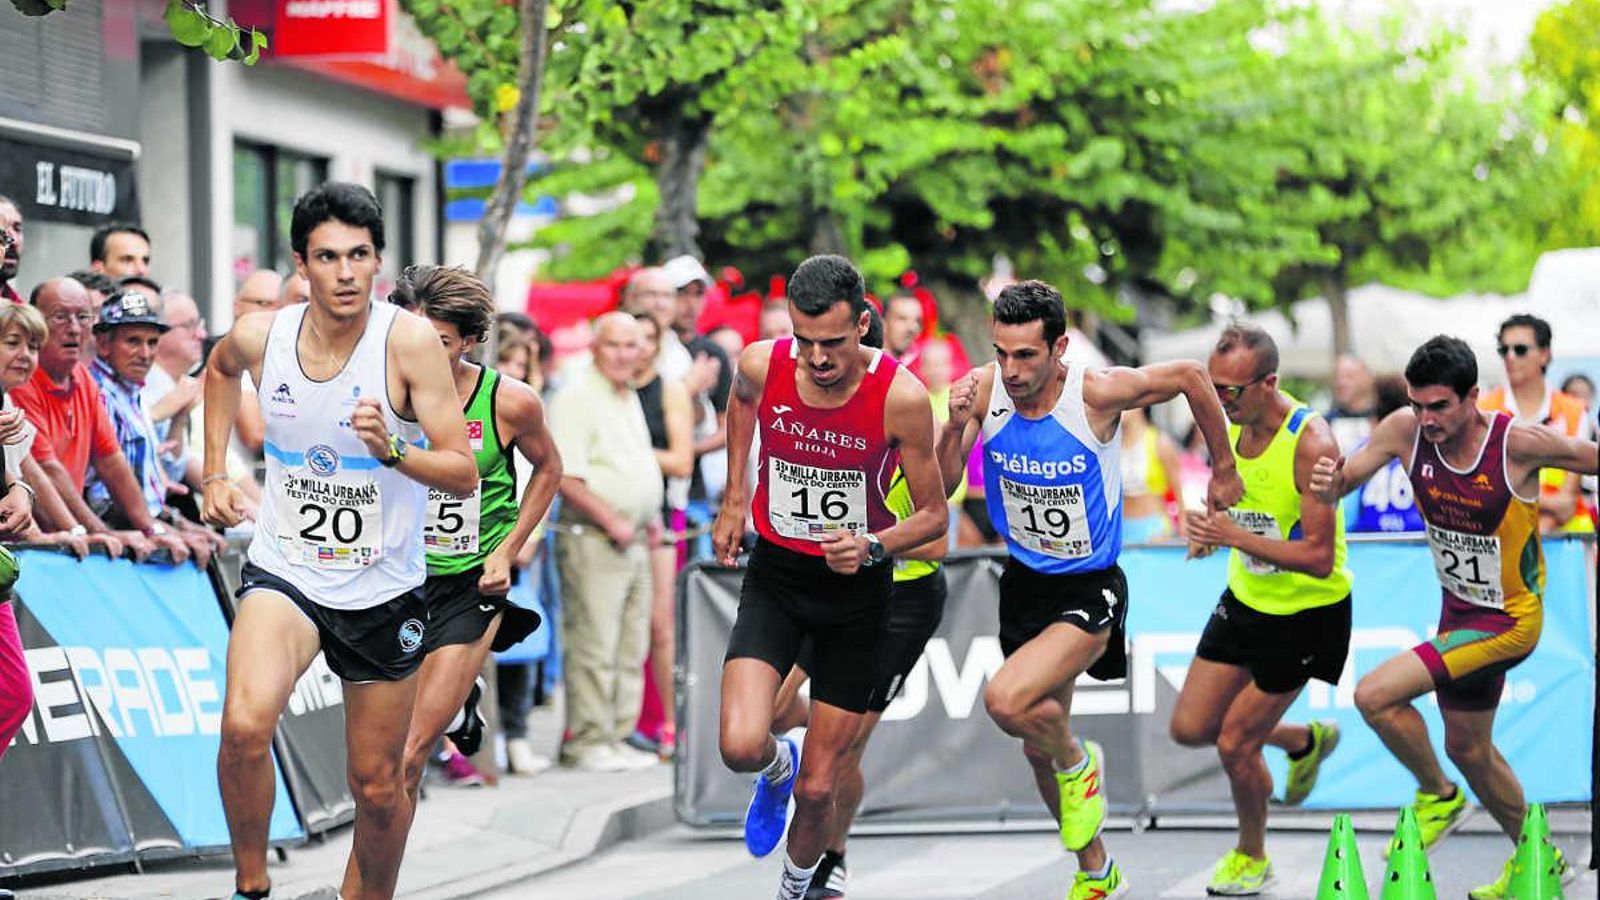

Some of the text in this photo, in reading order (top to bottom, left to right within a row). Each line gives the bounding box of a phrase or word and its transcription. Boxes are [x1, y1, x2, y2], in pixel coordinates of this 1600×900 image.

[36, 161, 57, 205] EL
[771, 417, 866, 450] AÑARES
[795, 441, 836, 458] RIOJA
[779, 472, 860, 489] FESTAS DO CRISTO
[790, 466, 818, 480] MILLA
[820, 471, 863, 482] URBANA
[300, 479, 330, 496] MILLA
[333, 484, 378, 500] URBANA
[1015, 484, 1039, 498] MILLA
[1040, 486, 1080, 499] URBANA
[322, 496, 336, 505] DO
[339, 498, 375, 507] CRISTO
[791, 488, 849, 520] 16
[299, 503, 363, 544] 20
[1021, 505, 1070, 538] 19
[1461, 536, 1497, 549] URBANA
[1441, 549, 1489, 585] 21
